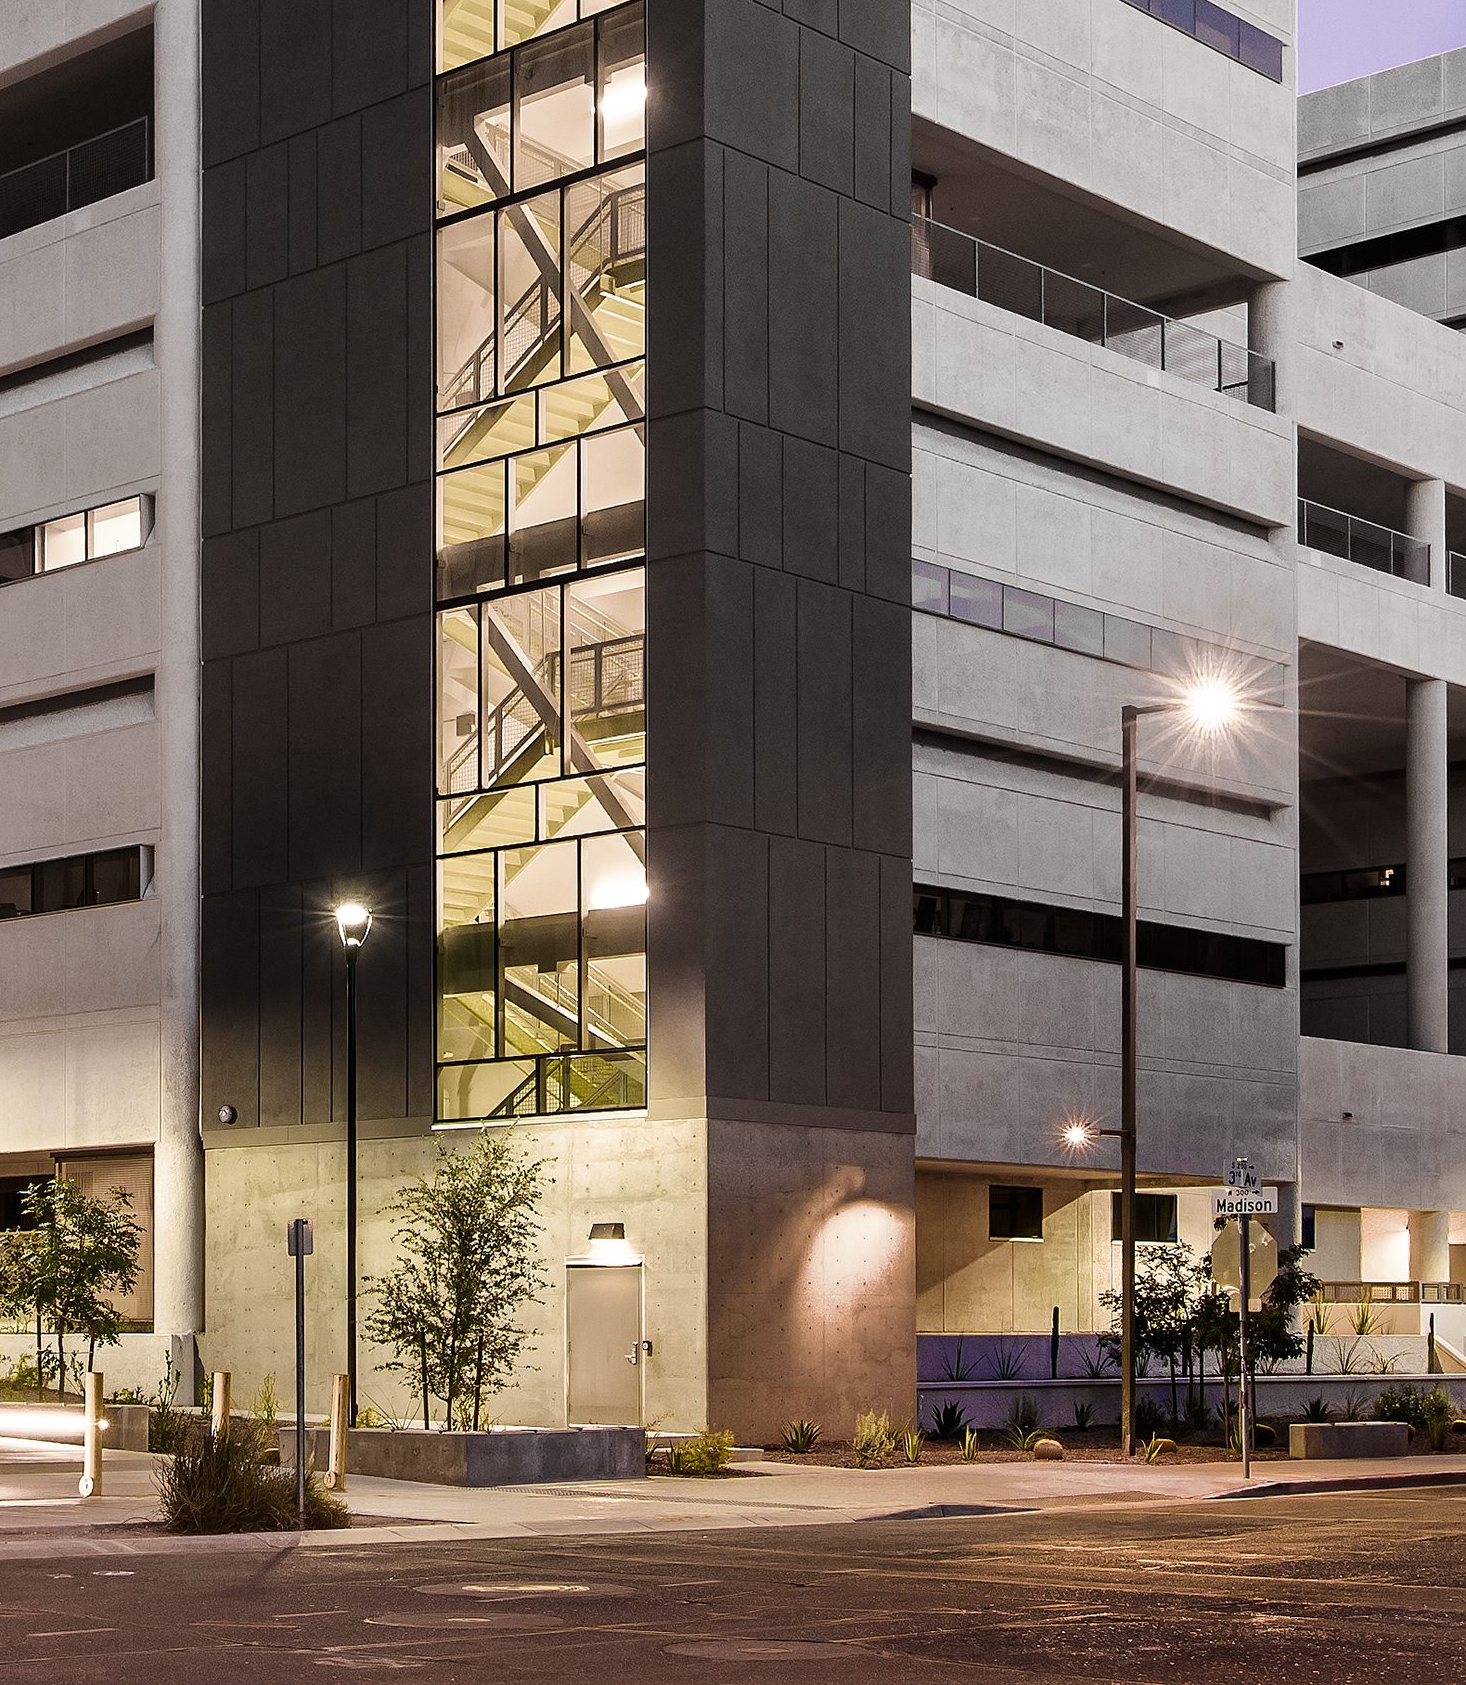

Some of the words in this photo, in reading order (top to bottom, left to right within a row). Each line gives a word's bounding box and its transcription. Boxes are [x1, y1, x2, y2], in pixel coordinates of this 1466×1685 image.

[1228, 1170, 1242, 1185] 3rd
[1244, 1172, 1257, 1188] Av
[1216, 1197, 1272, 1213] Madison
